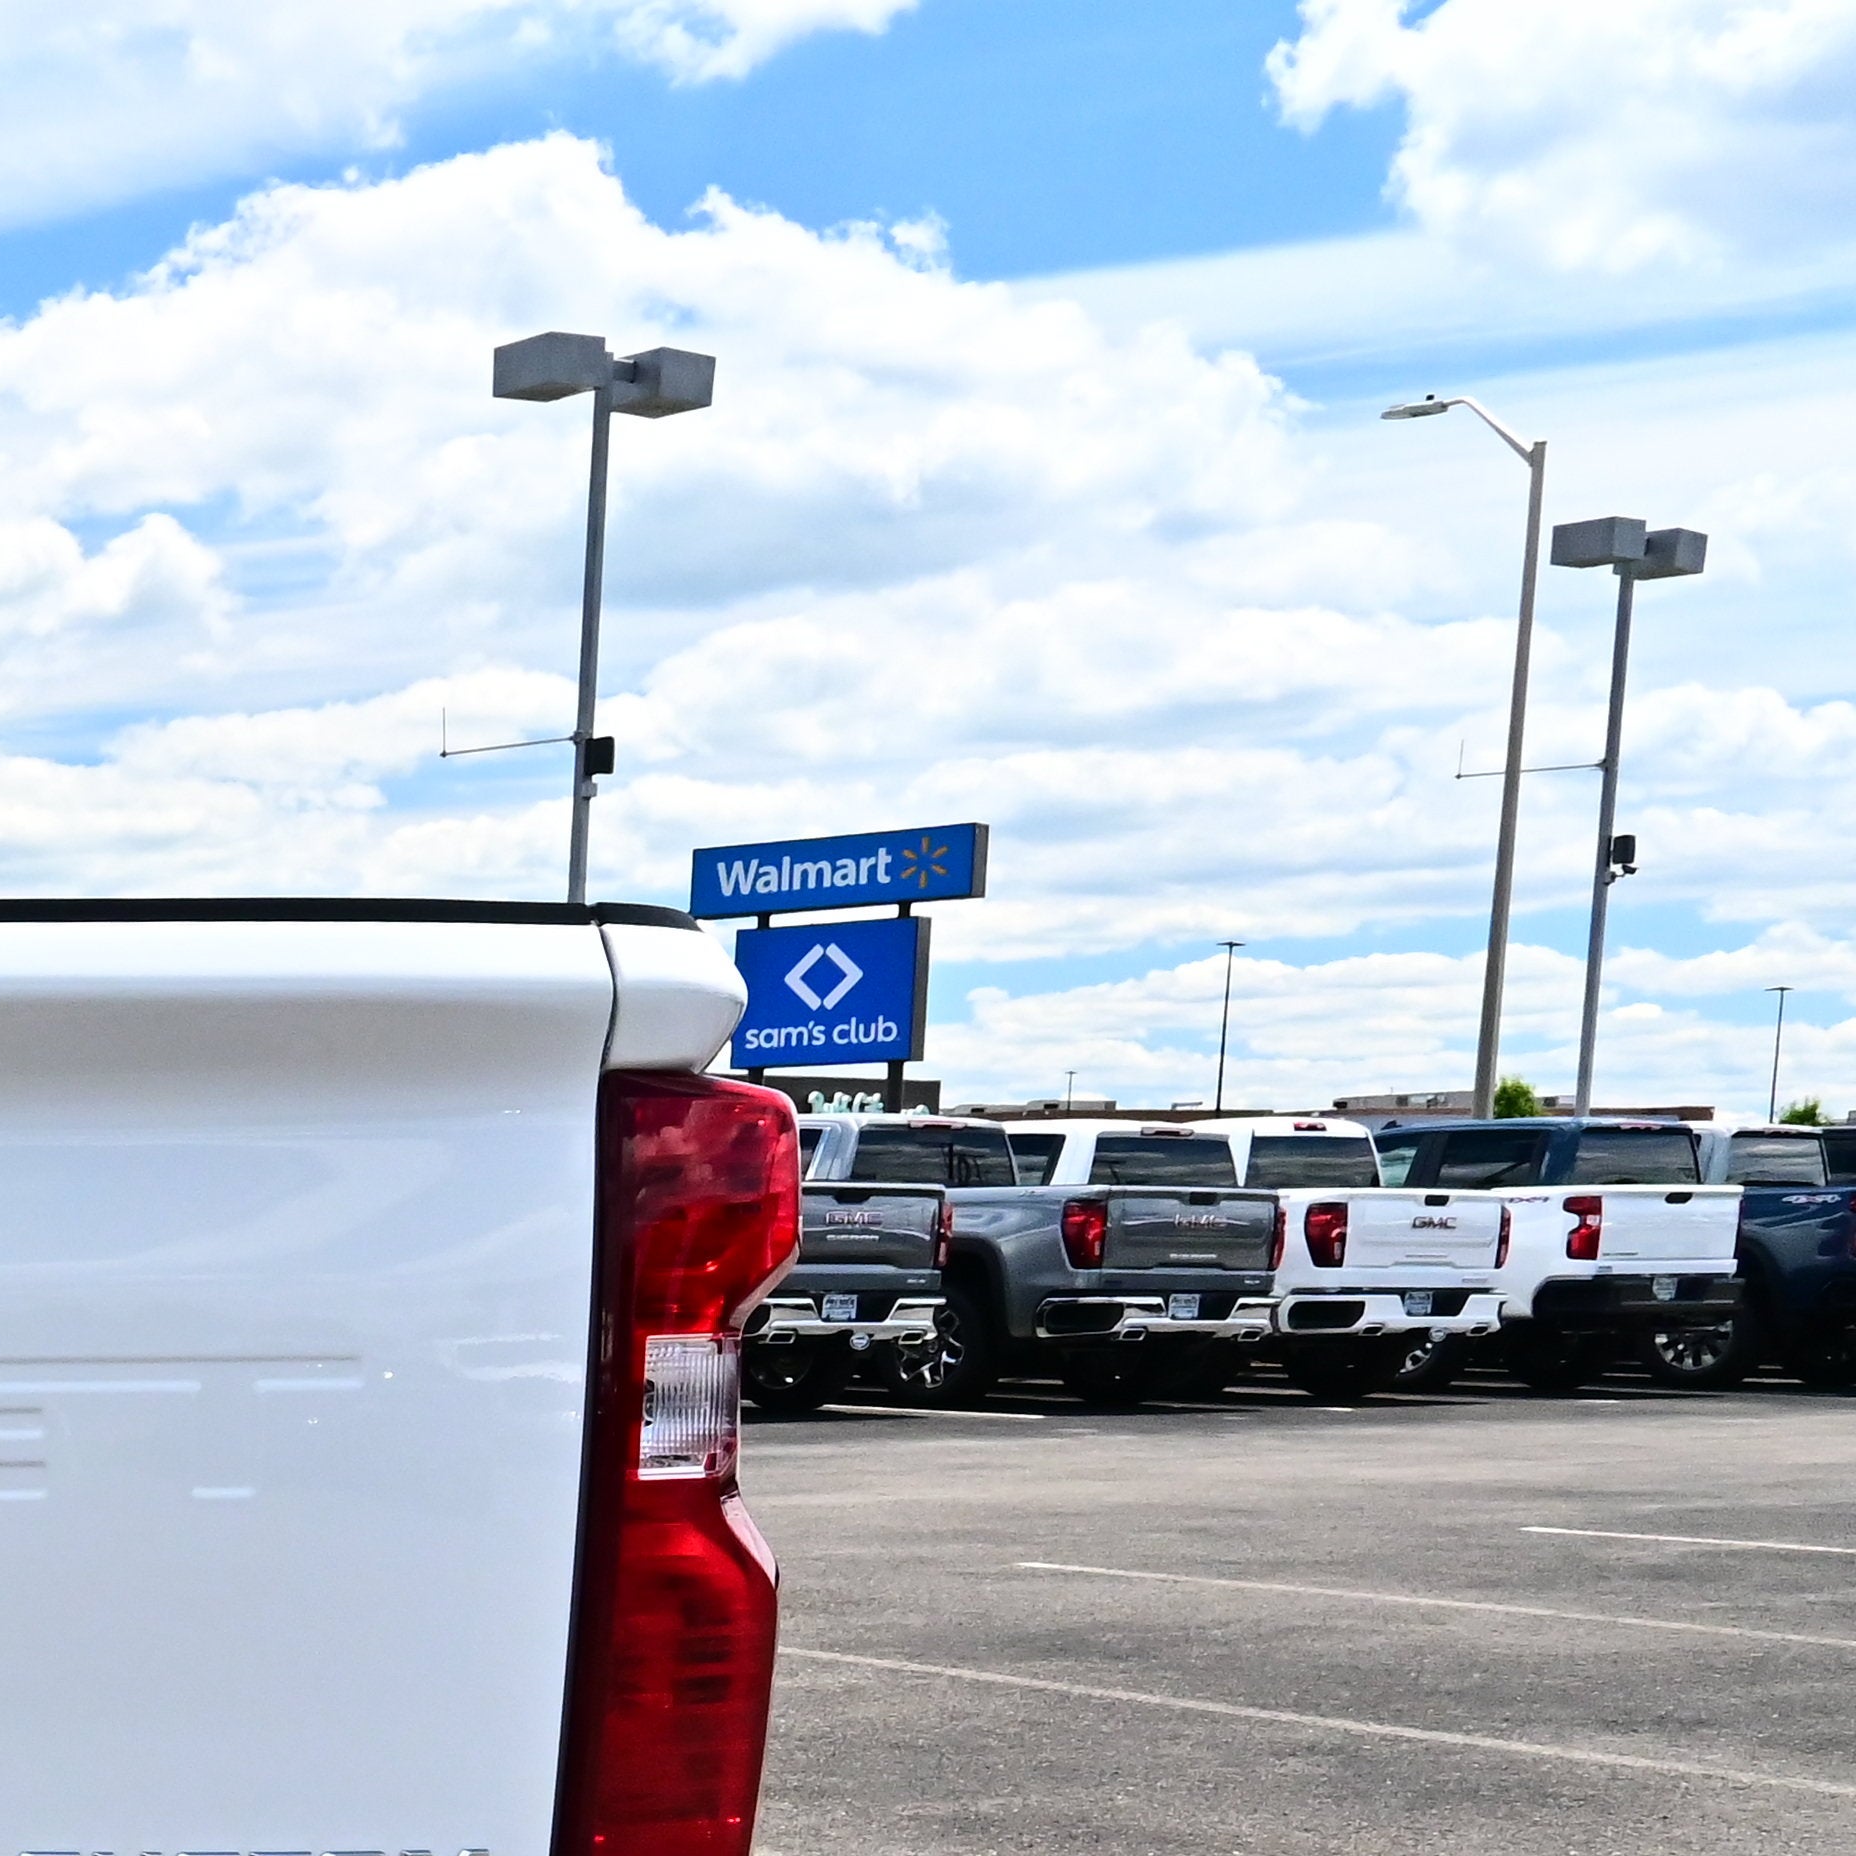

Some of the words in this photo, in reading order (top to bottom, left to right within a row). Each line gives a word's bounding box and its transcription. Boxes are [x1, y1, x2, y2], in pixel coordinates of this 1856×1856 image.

[717, 847, 892, 897] Walmart
[745, 1020, 826, 1049] sam's
[832, 1015, 898, 1044] club
[1411, 1216, 1457, 1230] GMC
